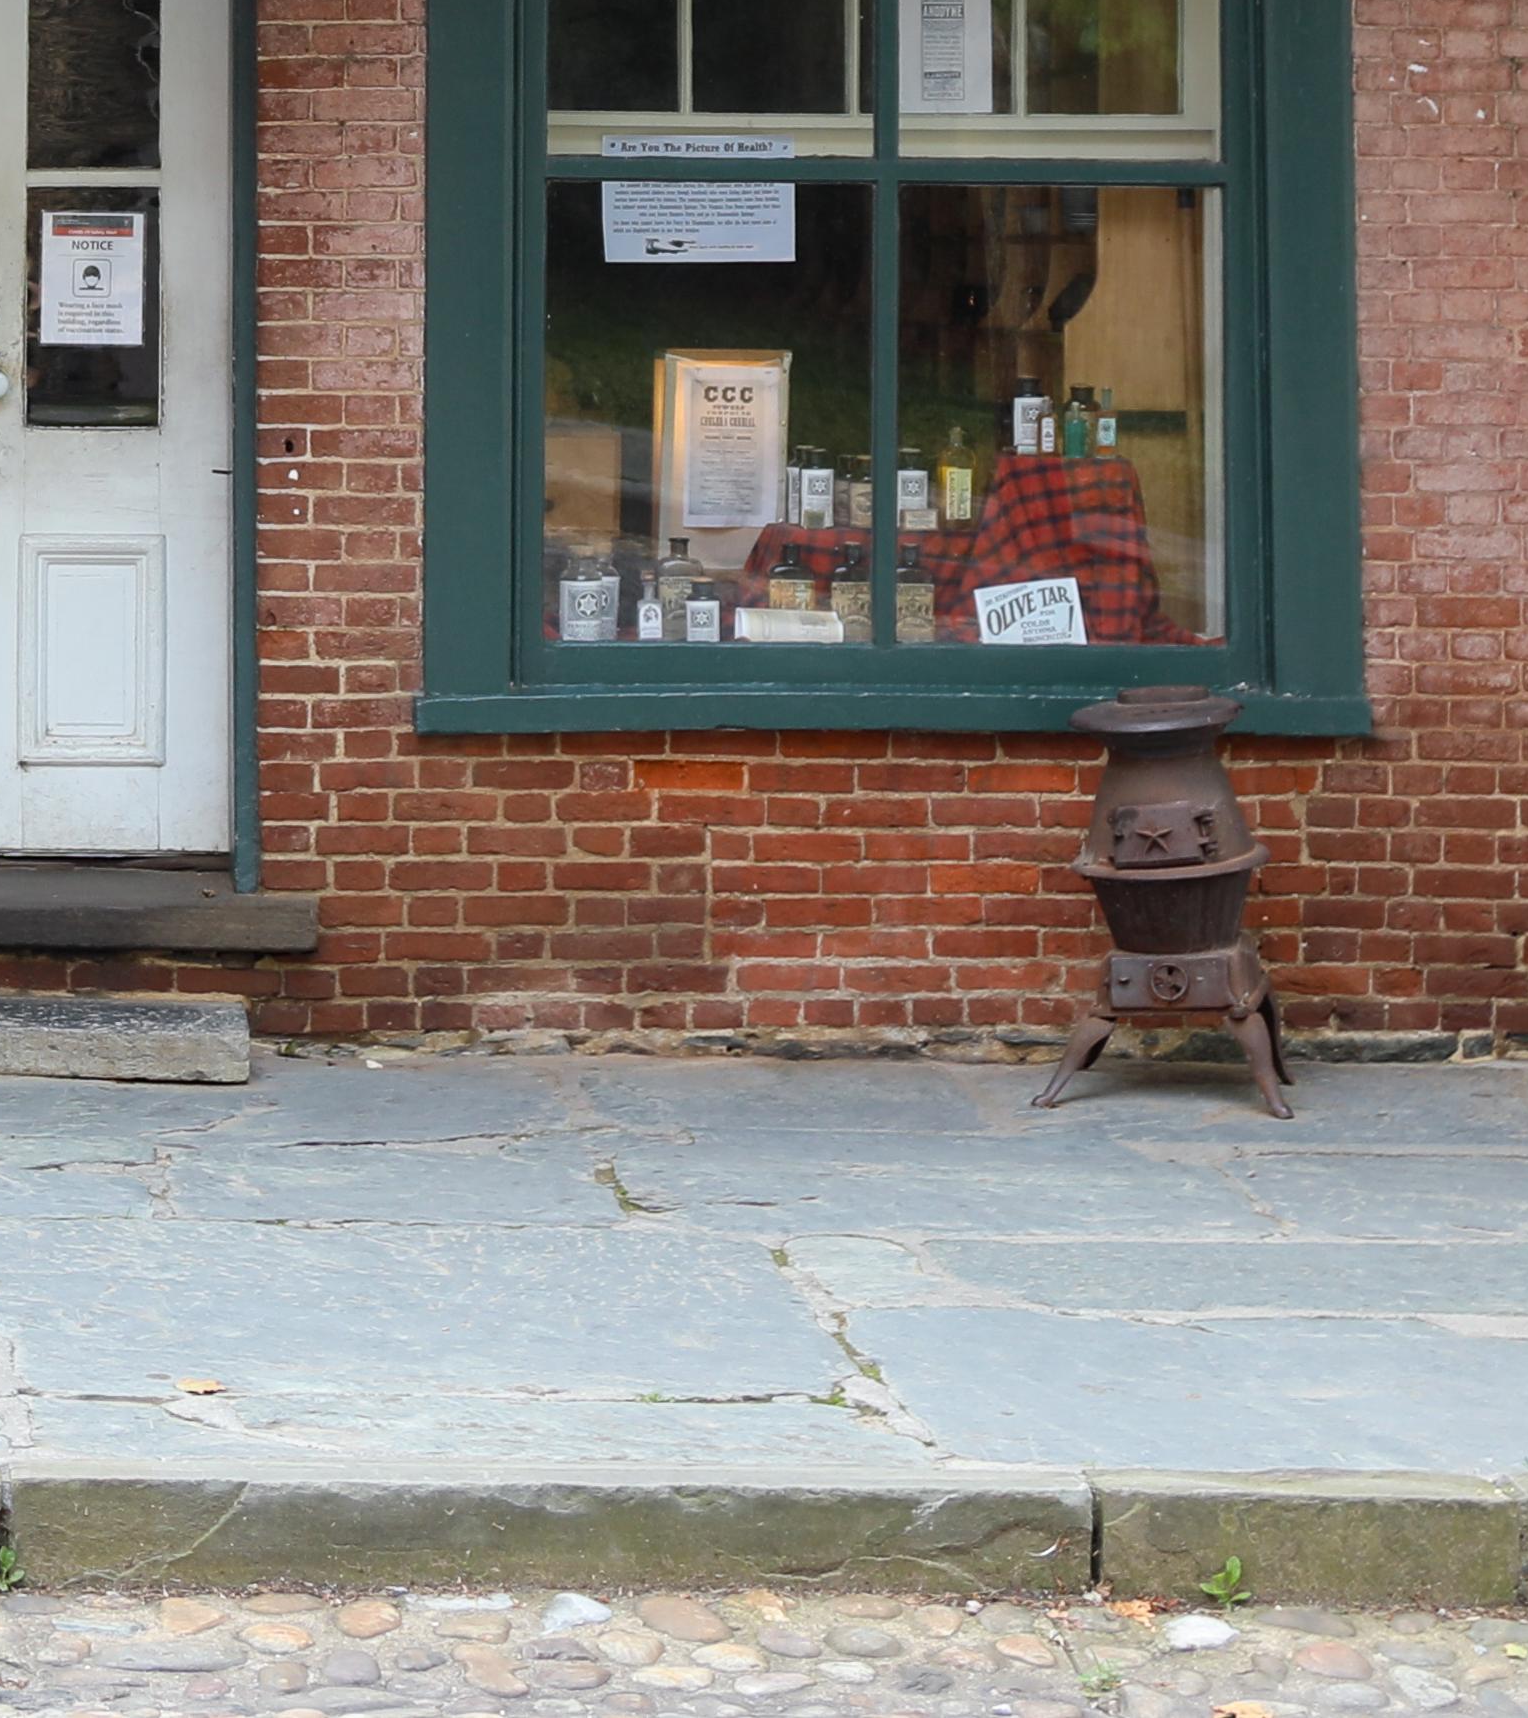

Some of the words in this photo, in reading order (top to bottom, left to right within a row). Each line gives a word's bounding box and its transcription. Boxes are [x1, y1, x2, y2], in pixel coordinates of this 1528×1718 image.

[621, 142, 637, 152] Are
[641, 142, 660, 152] You
[663, 143, 682, 152] The
[685, 142, 720, 152] Picture
[724, 141, 735, 152] Of
[737, 140, 773, 152] Health?
[72, 241, 114, 250] NOTICE
[987, 591, 1037, 636] OLIVE
[1037, 586, 1074, 608] TAR
